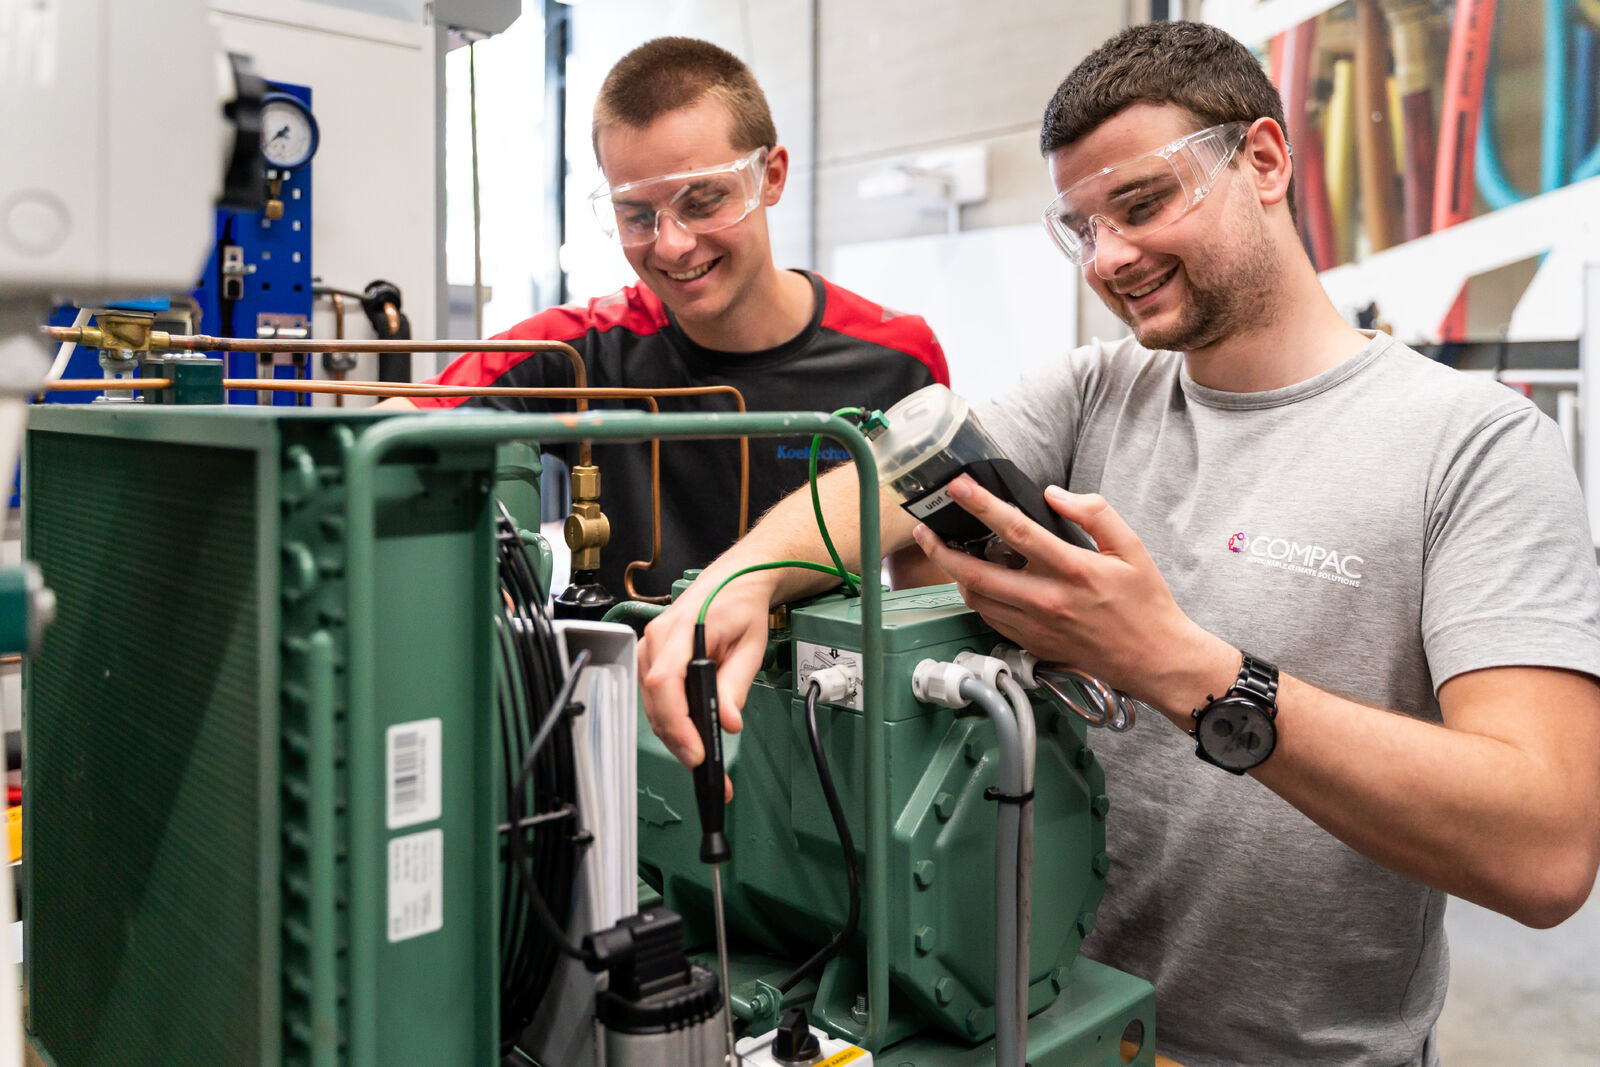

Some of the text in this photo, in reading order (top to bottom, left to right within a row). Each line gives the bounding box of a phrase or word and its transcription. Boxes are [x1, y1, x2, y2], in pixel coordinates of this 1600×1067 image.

[925, 495, 944, 510] unit
[1247, 556, 1361, 588] INABLE CLIMATE SOLUTIONS
[1250, 535, 1364, 579] COMPAC
